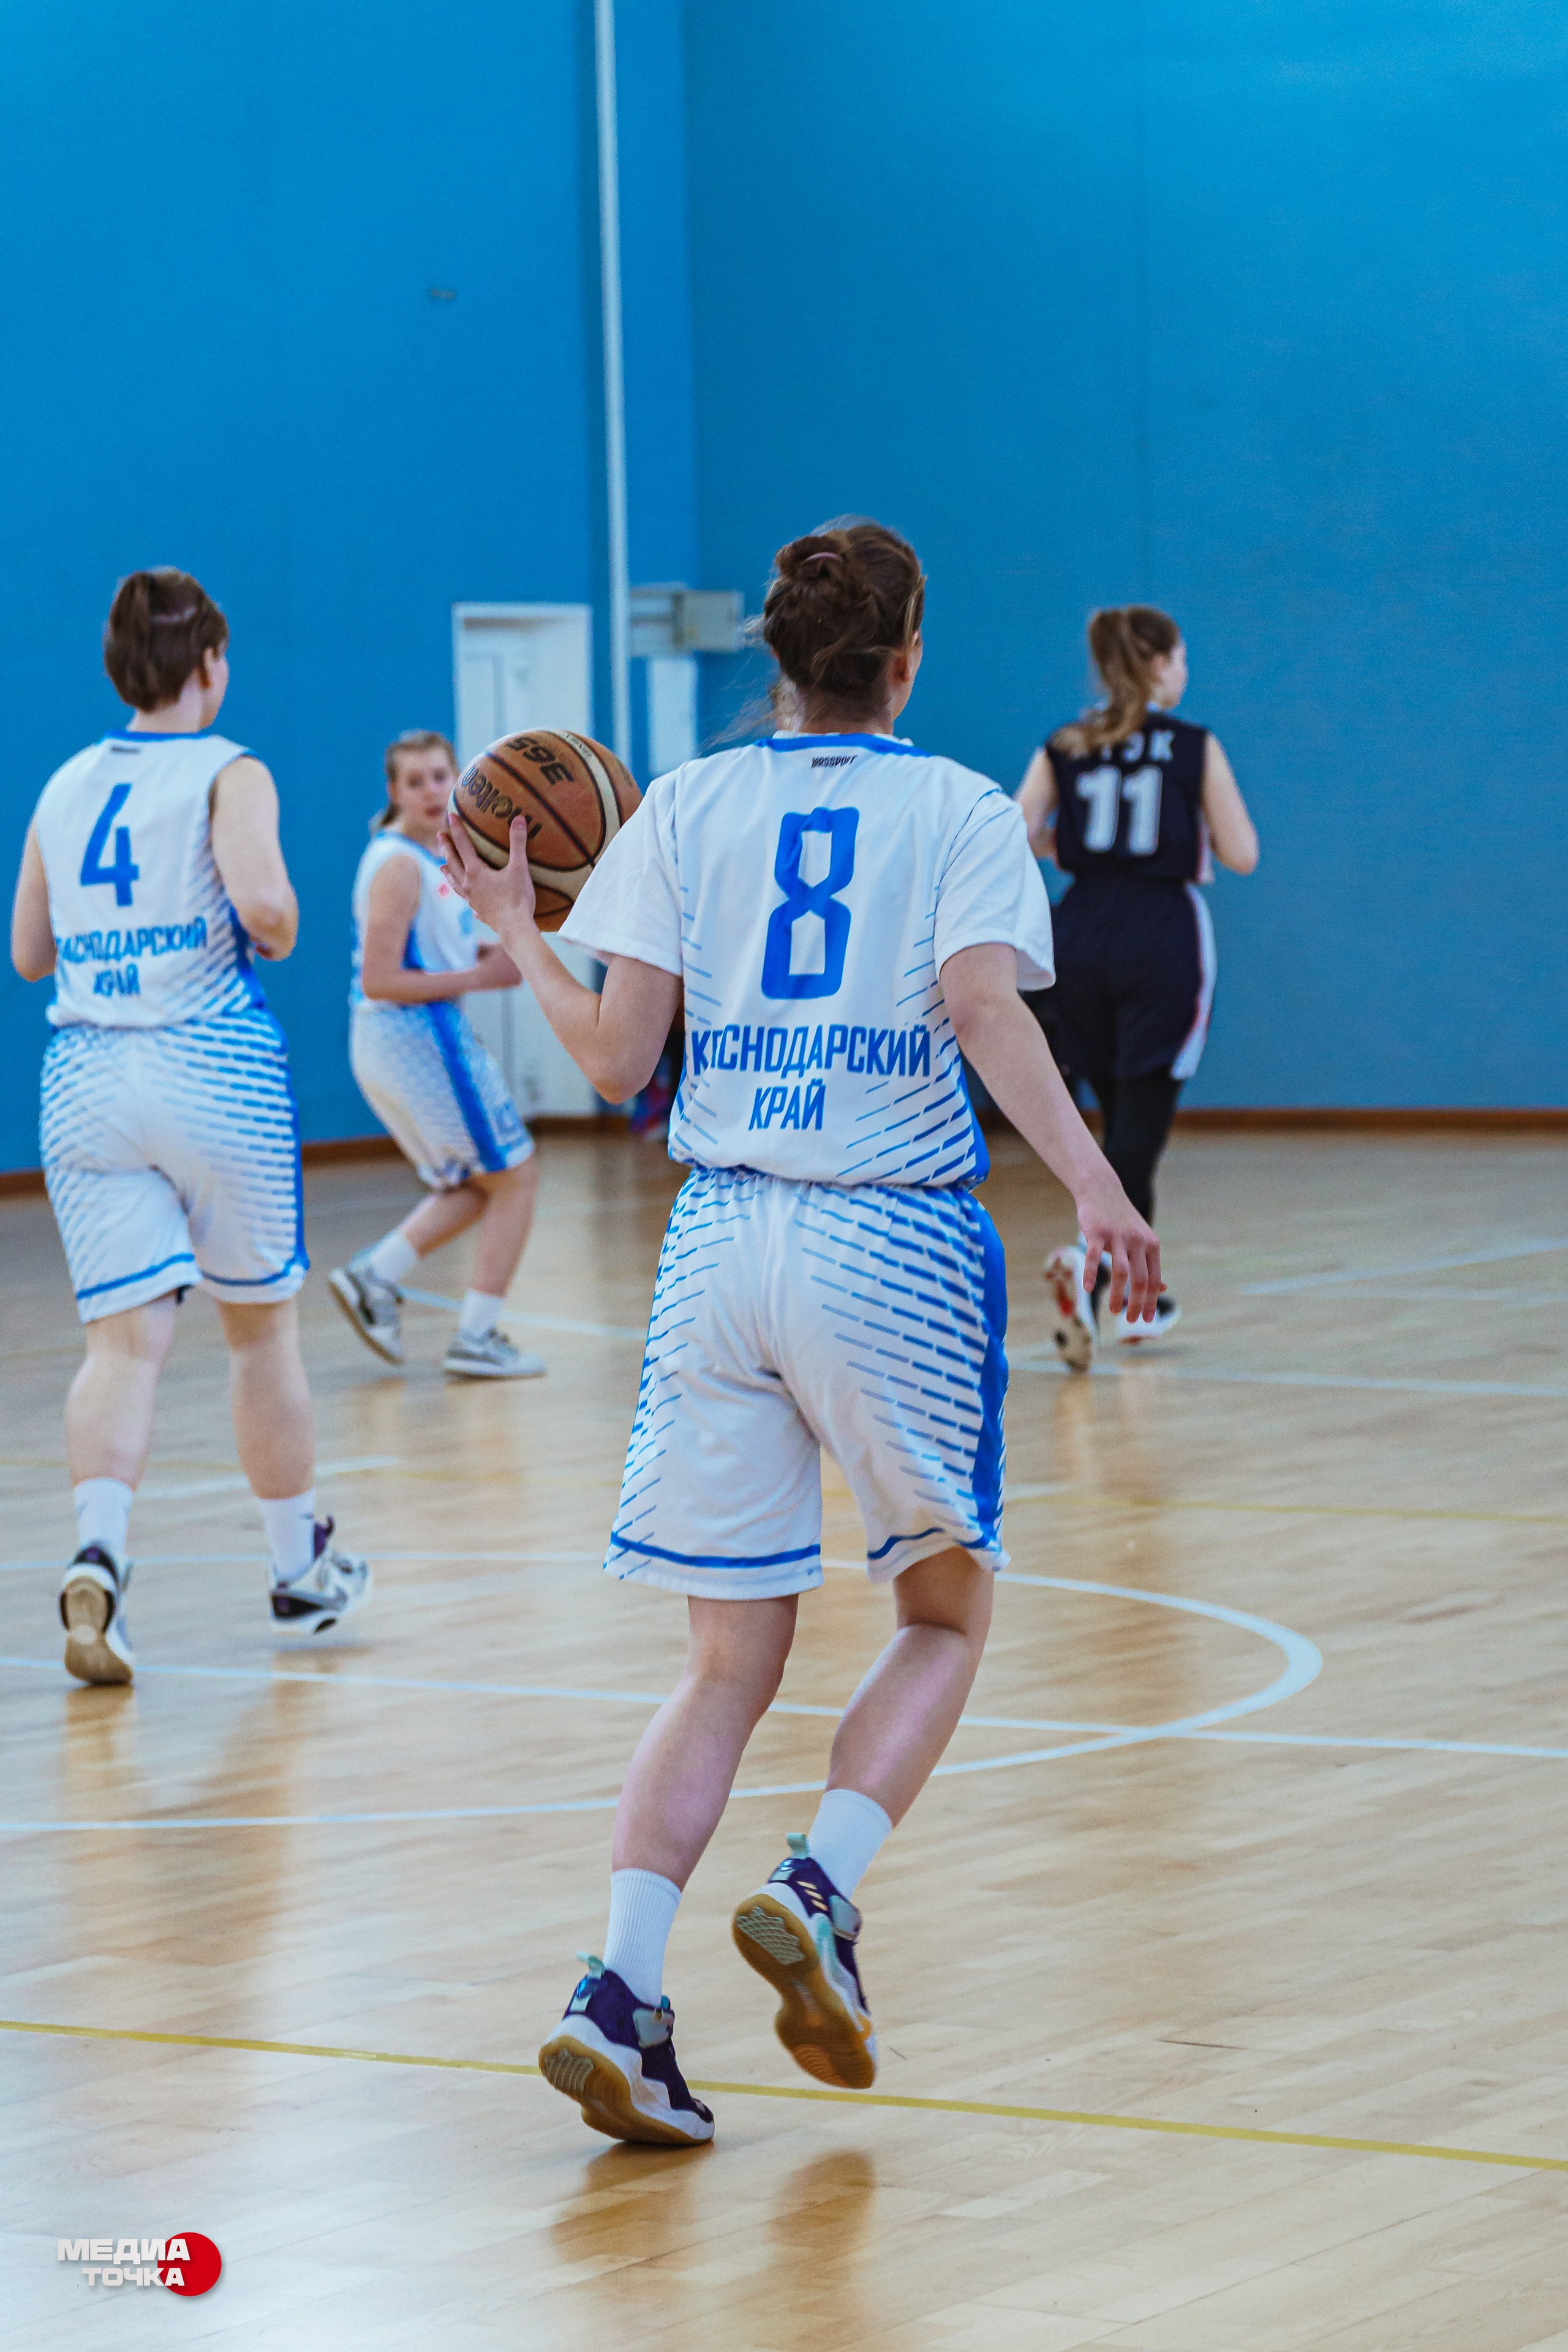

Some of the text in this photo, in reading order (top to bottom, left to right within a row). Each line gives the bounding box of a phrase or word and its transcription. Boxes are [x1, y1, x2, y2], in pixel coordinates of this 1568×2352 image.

[506, 736, 575, 786] 365
[80, 783, 140, 907] 4
[1076, 766, 1162, 856] 11
[761, 806, 860, 1000] 8
[692, 1024, 930, 1079] КСНОДАРСКИЙ
[748, 1078, 826, 1131] КРАЙ
